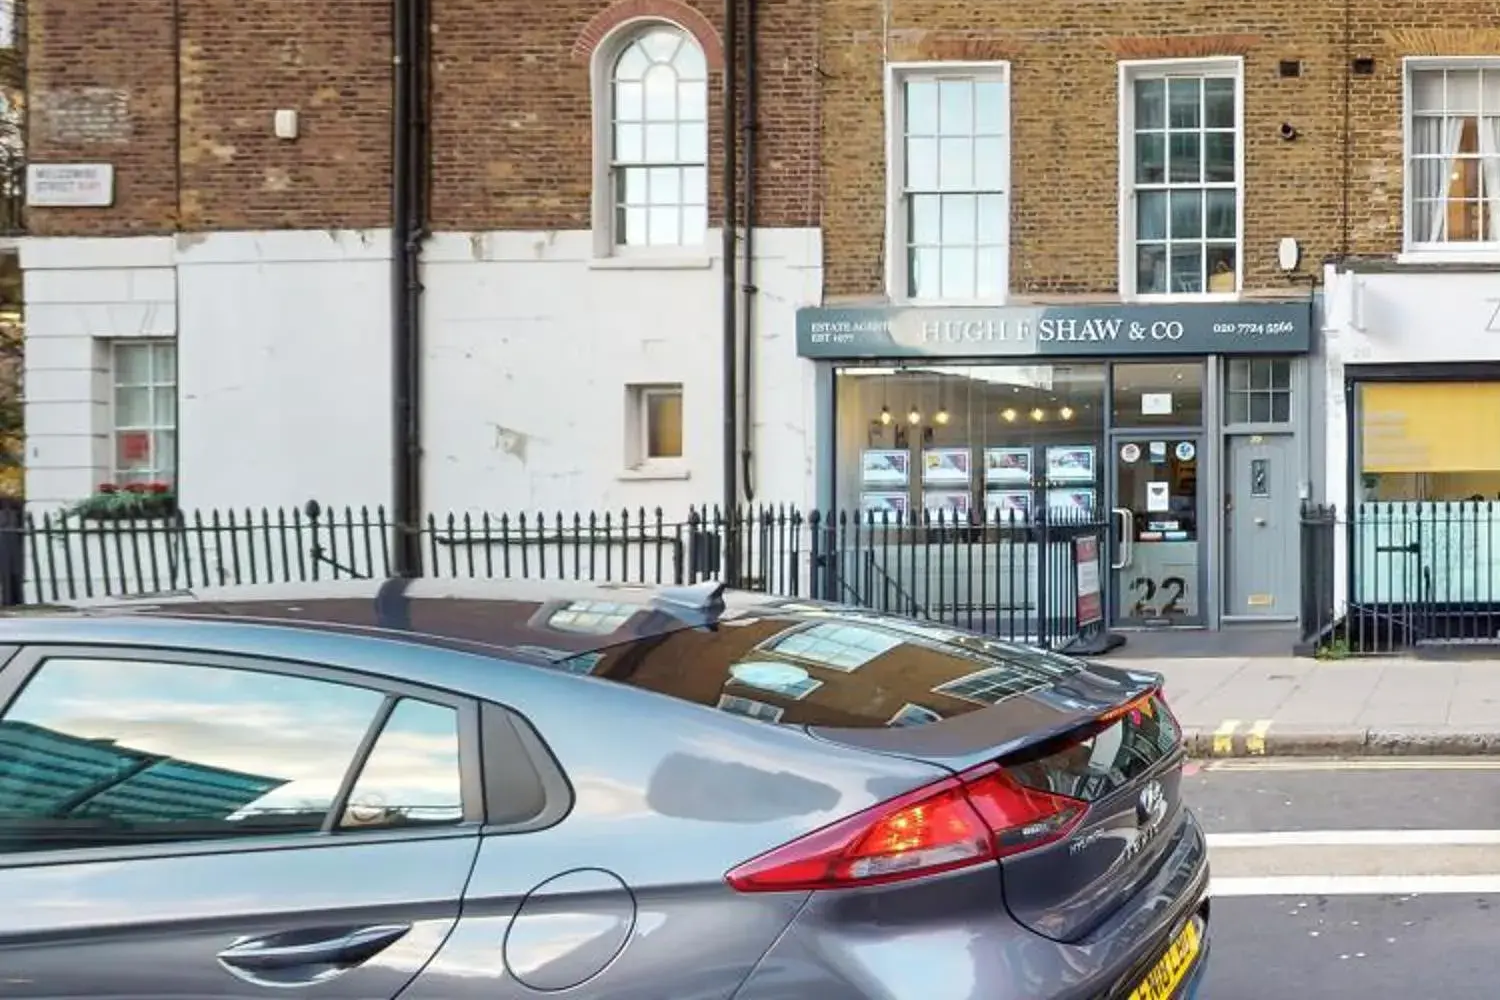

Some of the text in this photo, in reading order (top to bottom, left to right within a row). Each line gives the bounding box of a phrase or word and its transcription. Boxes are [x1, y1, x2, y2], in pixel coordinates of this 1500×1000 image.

[811, 322, 850, 332] ESTATE
[922, 320, 1008, 342] HUGH
[1039, 318, 1124, 341] SHAW
[1128, 321, 1147, 340] &
[1151, 320, 1184, 340] CO
[1213, 323, 1236, 333] 020
[1129, 577, 1188, 617] 22
